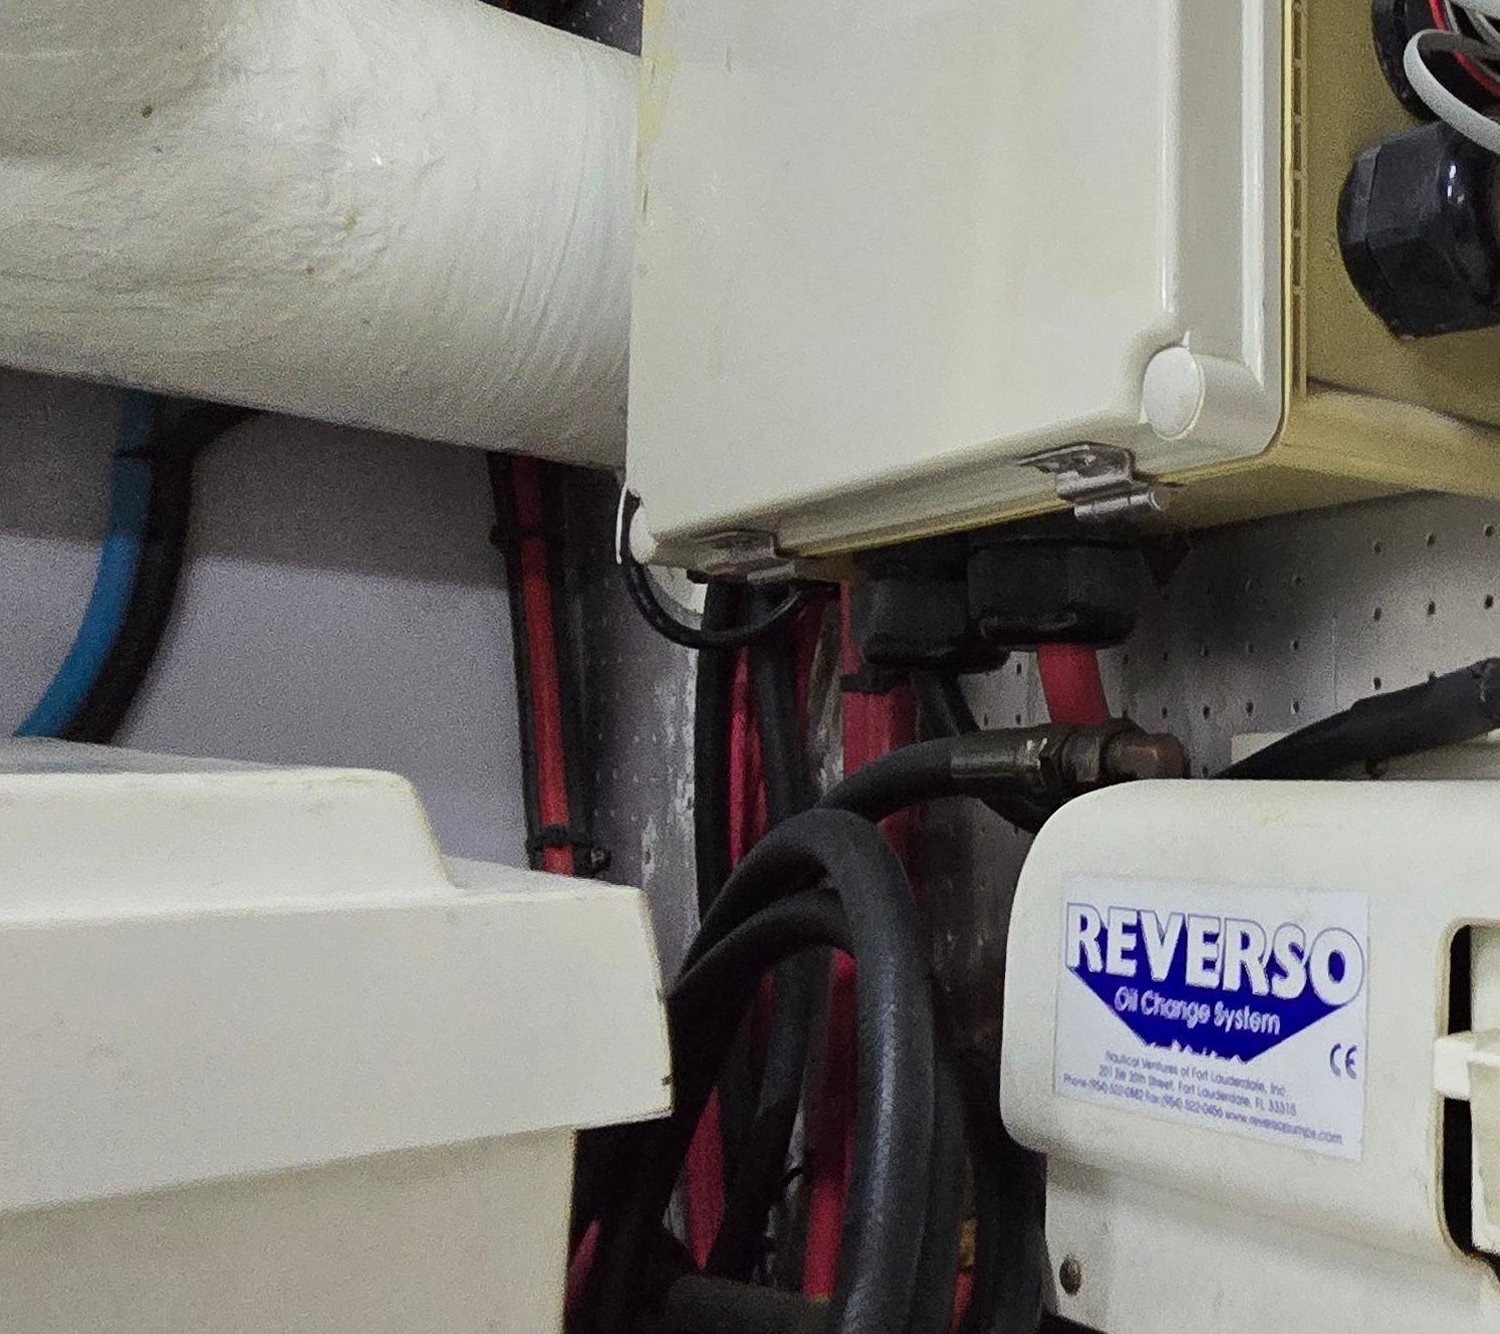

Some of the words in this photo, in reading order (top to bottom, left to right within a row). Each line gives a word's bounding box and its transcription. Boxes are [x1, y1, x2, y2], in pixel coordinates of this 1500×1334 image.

[1065, 902, 1365, 1006] REVERSO
[1114, 985, 1139, 1012] Oil
[1141, 989, 1211, 1028] Change
[1213, 1000, 1281, 1035] System
[1191, 1067, 1209, 1081] Fort
[1179, 1080, 1195, 1094] Fort
[1255, 1096, 1265, 1112] FL
